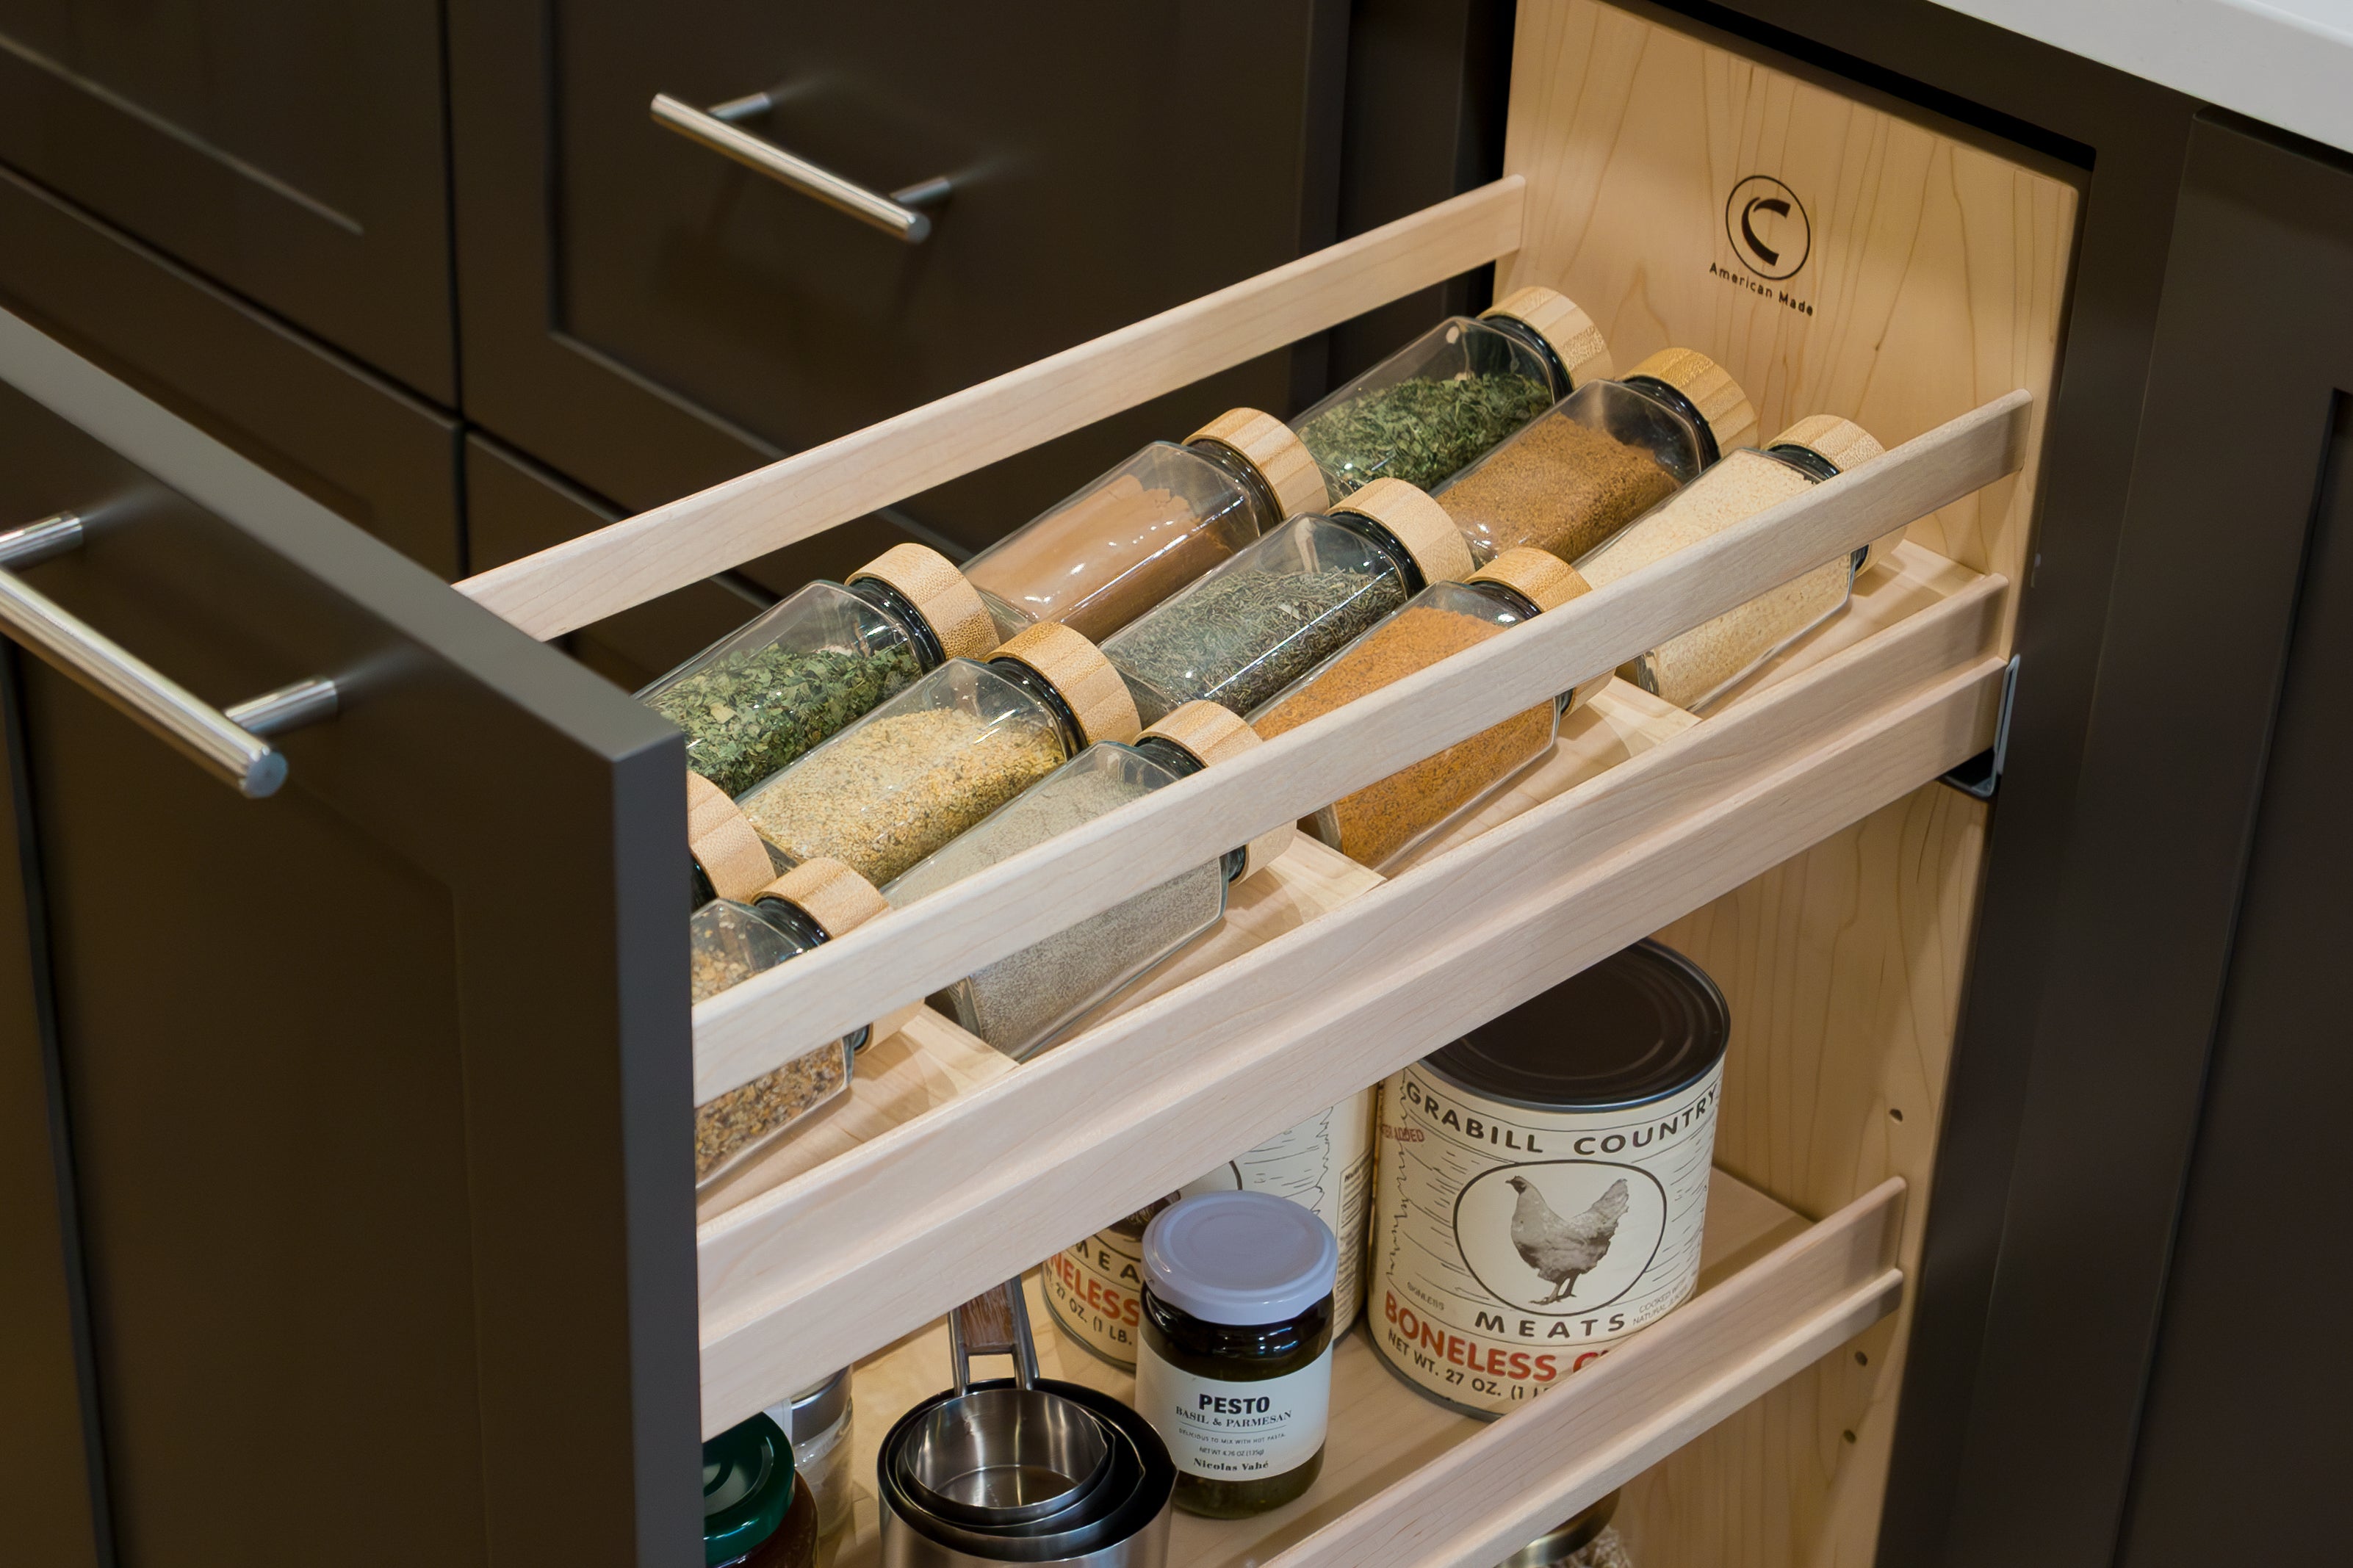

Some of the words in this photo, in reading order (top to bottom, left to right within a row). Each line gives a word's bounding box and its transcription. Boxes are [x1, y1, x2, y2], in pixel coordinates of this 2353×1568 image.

[1709, 261, 1773, 297] American
[1779, 290, 1813, 317] Made
[1406, 1081, 1543, 1153] GRABILL
[1574, 1083, 1718, 1156] COUNTRY
[1069, 1298, 1087, 1323] OZ.
[1110, 1325, 1133, 1345] LB.
[1385, 1290, 1557, 1382] BONELESS
[1474, 1311, 1625, 1339] MEATS
[1388, 1328, 1410, 1356] NET
[1413, 1350, 1439, 1376] WT.
[1445, 1368, 1465, 1386] 27
[1471, 1378, 1502, 1396] OZ.
[1510, 1384, 1524, 1401] (1
[1176, 1406, 1209, 1425] BASIL
[1212, 1417, 1222, 1426] &
[1226, 1409, 1292, 1428] PARMESAN
[1198, 1393, 1270, 1415] PESTO
[1193, 1457, 1238, 1471] Nicolas
[1242, 1460, 1269, 1471] Vahé
